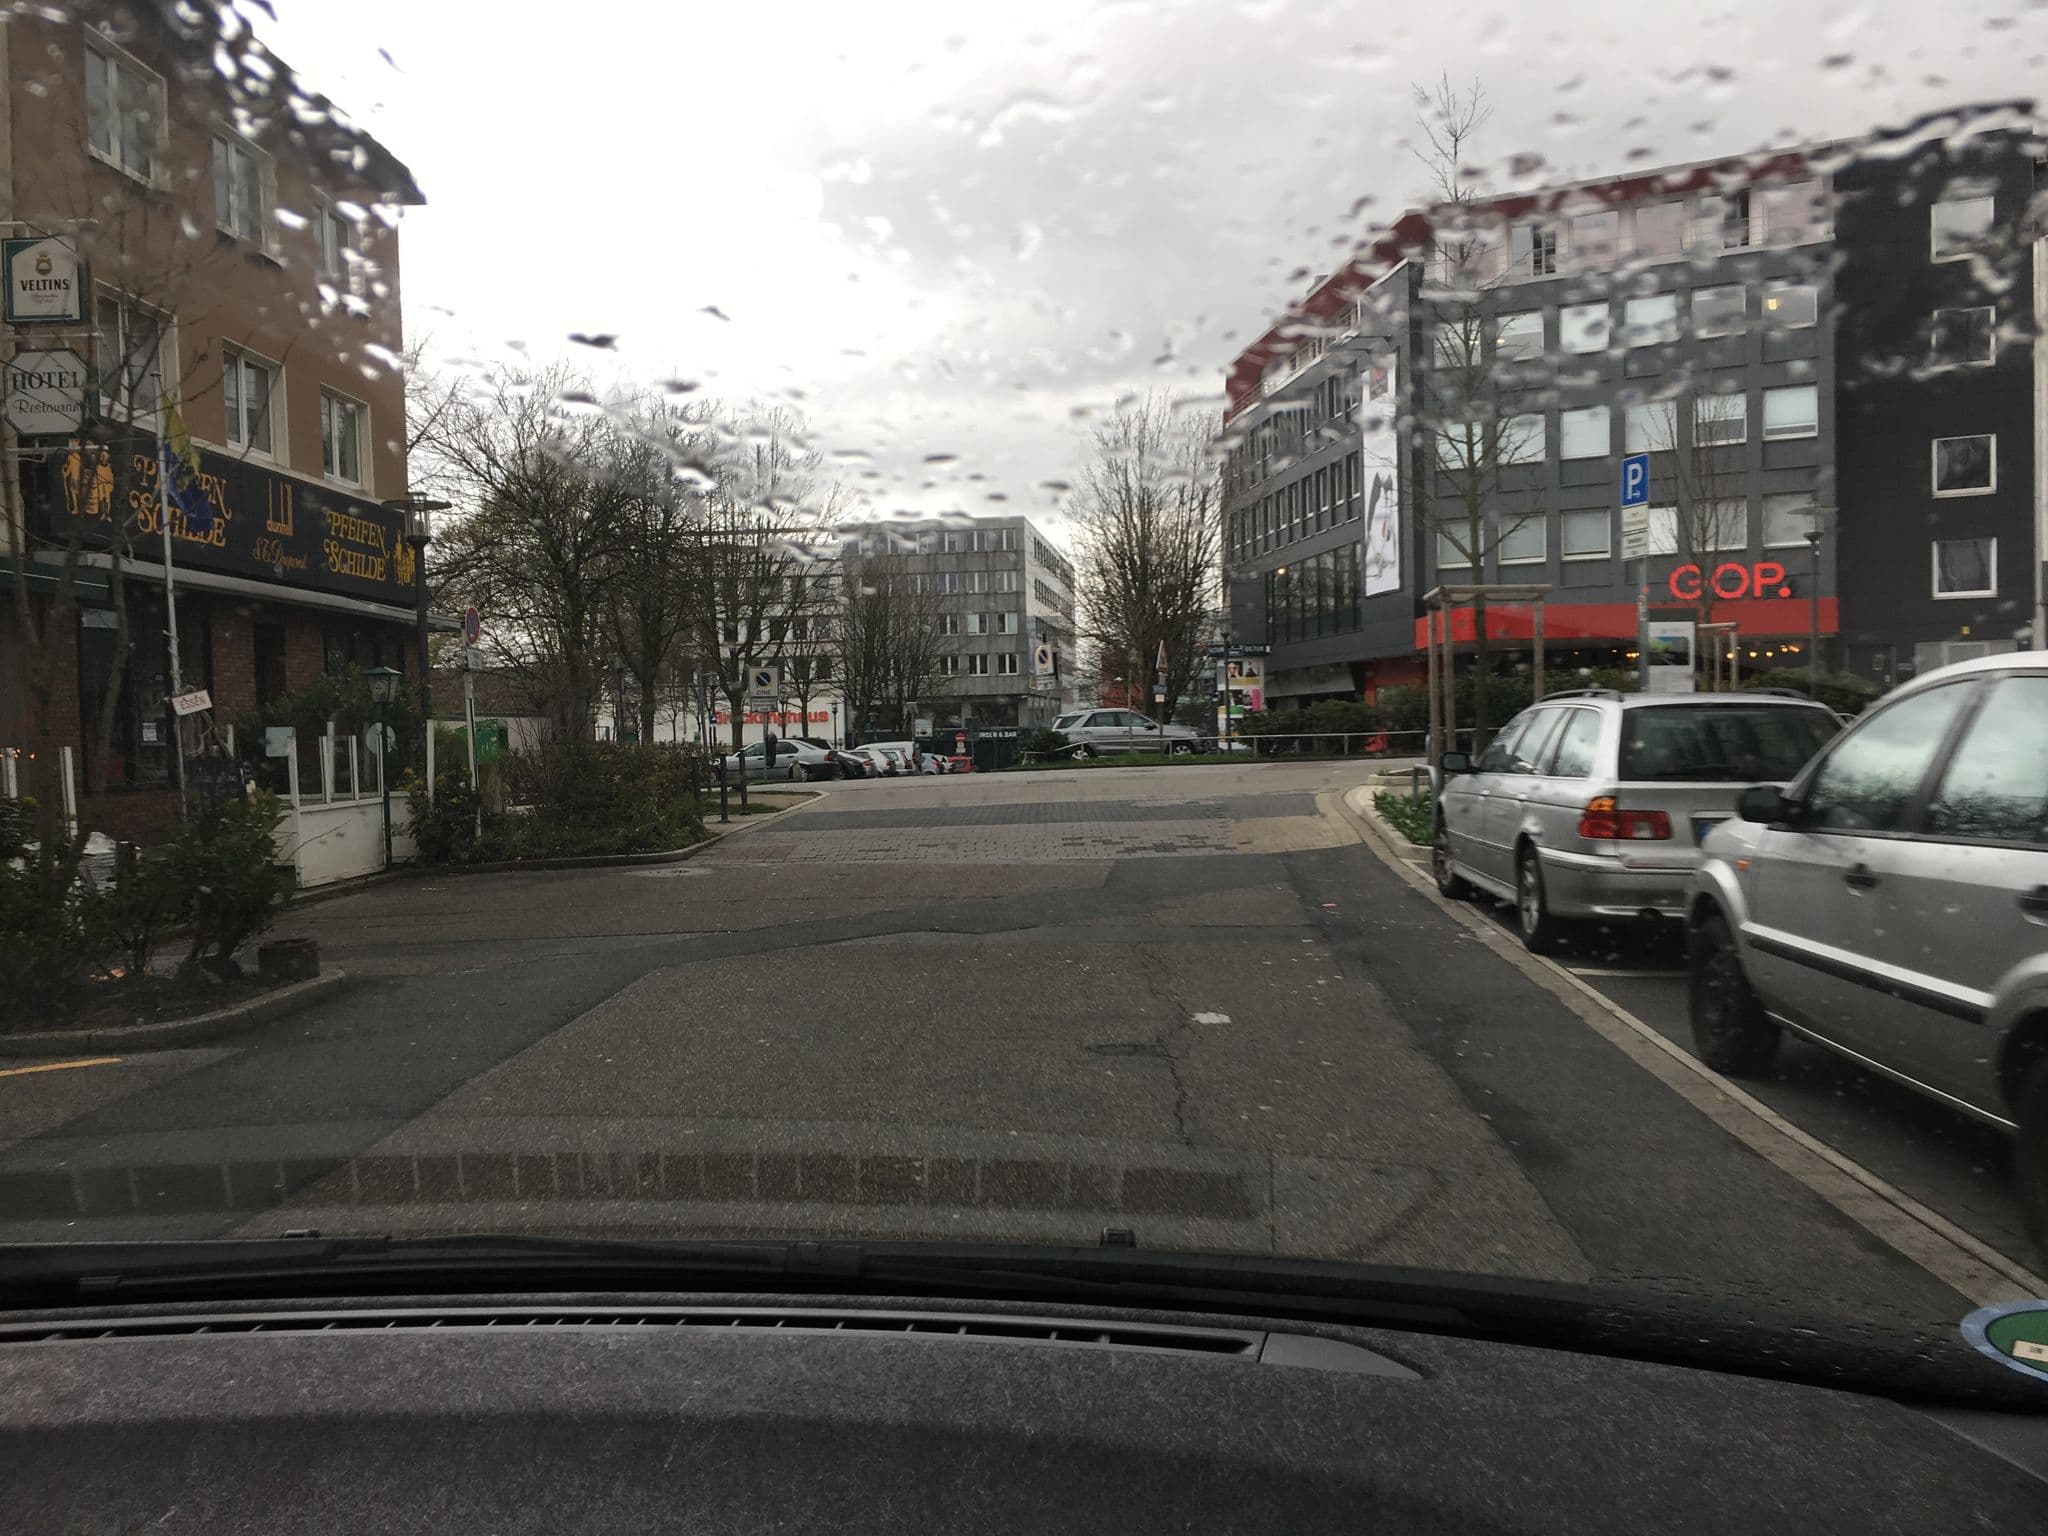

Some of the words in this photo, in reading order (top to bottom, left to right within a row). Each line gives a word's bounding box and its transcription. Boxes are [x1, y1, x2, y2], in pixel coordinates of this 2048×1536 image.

[20, 279, 71, 292] VELTINS
[12, 371, 84, 390] HOTEL
[1627, 463, 1643, 499] P
[327, 511, 391, 559] PFEIFEN
[323, 538, 386, 581] SCHILDE
